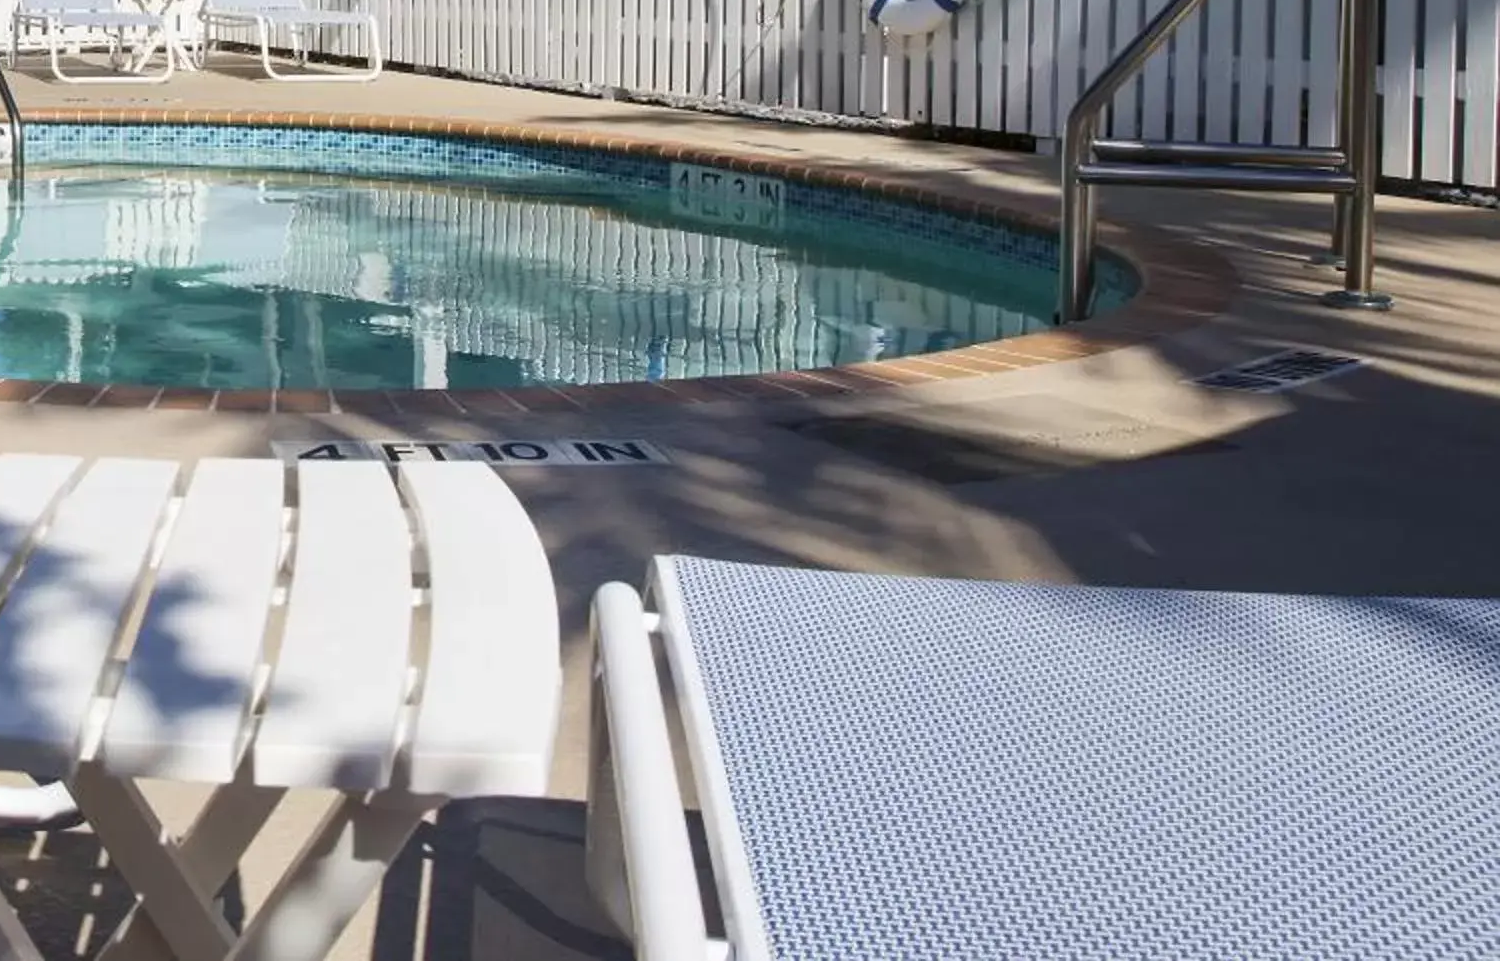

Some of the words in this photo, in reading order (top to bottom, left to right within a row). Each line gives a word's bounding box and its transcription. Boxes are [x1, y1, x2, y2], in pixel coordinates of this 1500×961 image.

[298, 444, 348, 460] 4
[381, 443, 449, 461] FT
[474, 442, 549, 461] 10
[572, 442, 651, 462] IN
